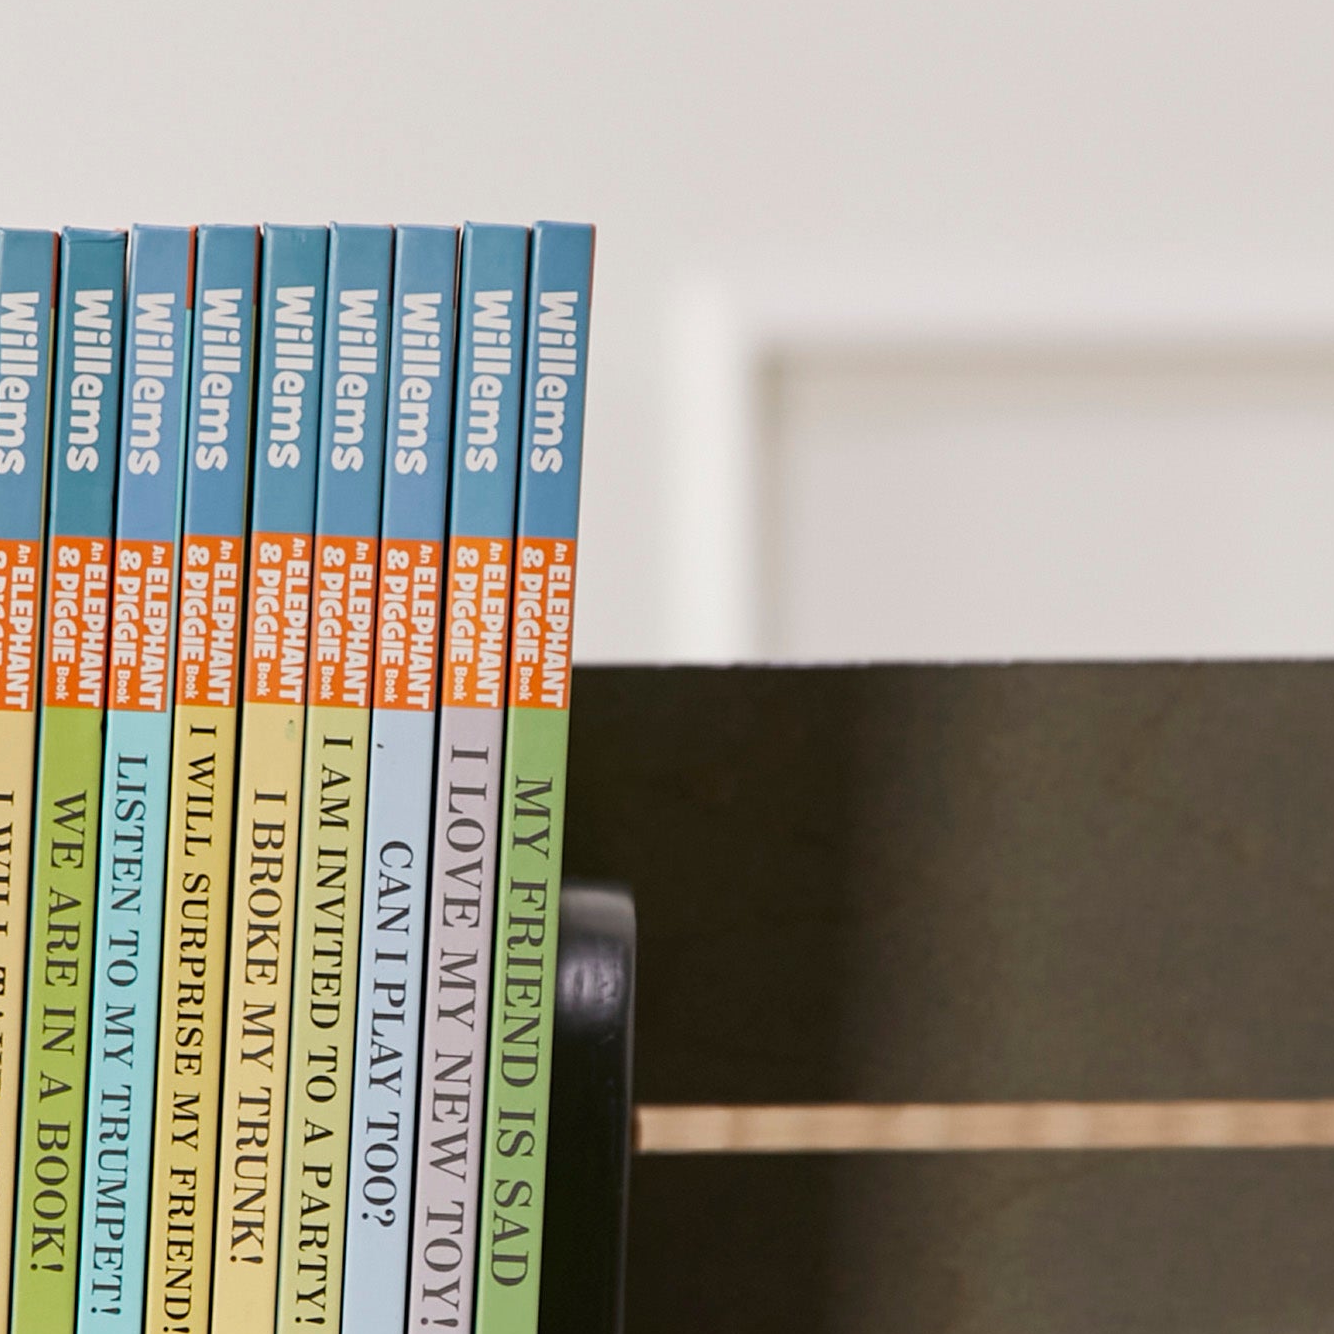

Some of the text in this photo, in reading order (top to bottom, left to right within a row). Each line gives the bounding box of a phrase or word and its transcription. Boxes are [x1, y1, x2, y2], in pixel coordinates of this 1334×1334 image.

[195, 288, 242, 471] Willems
[394, 292, 442, 475] Willems
[530, 291, 578, 473] Willems
[514, 546, 544, 700] & PIGGIE Book
[541, 543, 571, 708] An ELEPHANT
[90, 753, 148, 1315] LISTEN TO MY TRUMPET!
[163, 725, 217, 1334] I WILL SURPRISE MY FRIEND!
[294, 736, 353, 1325] I AM INVITED TO A PARTY!
[490, 775, 553, 1287] MY FRIEND IS SAD
